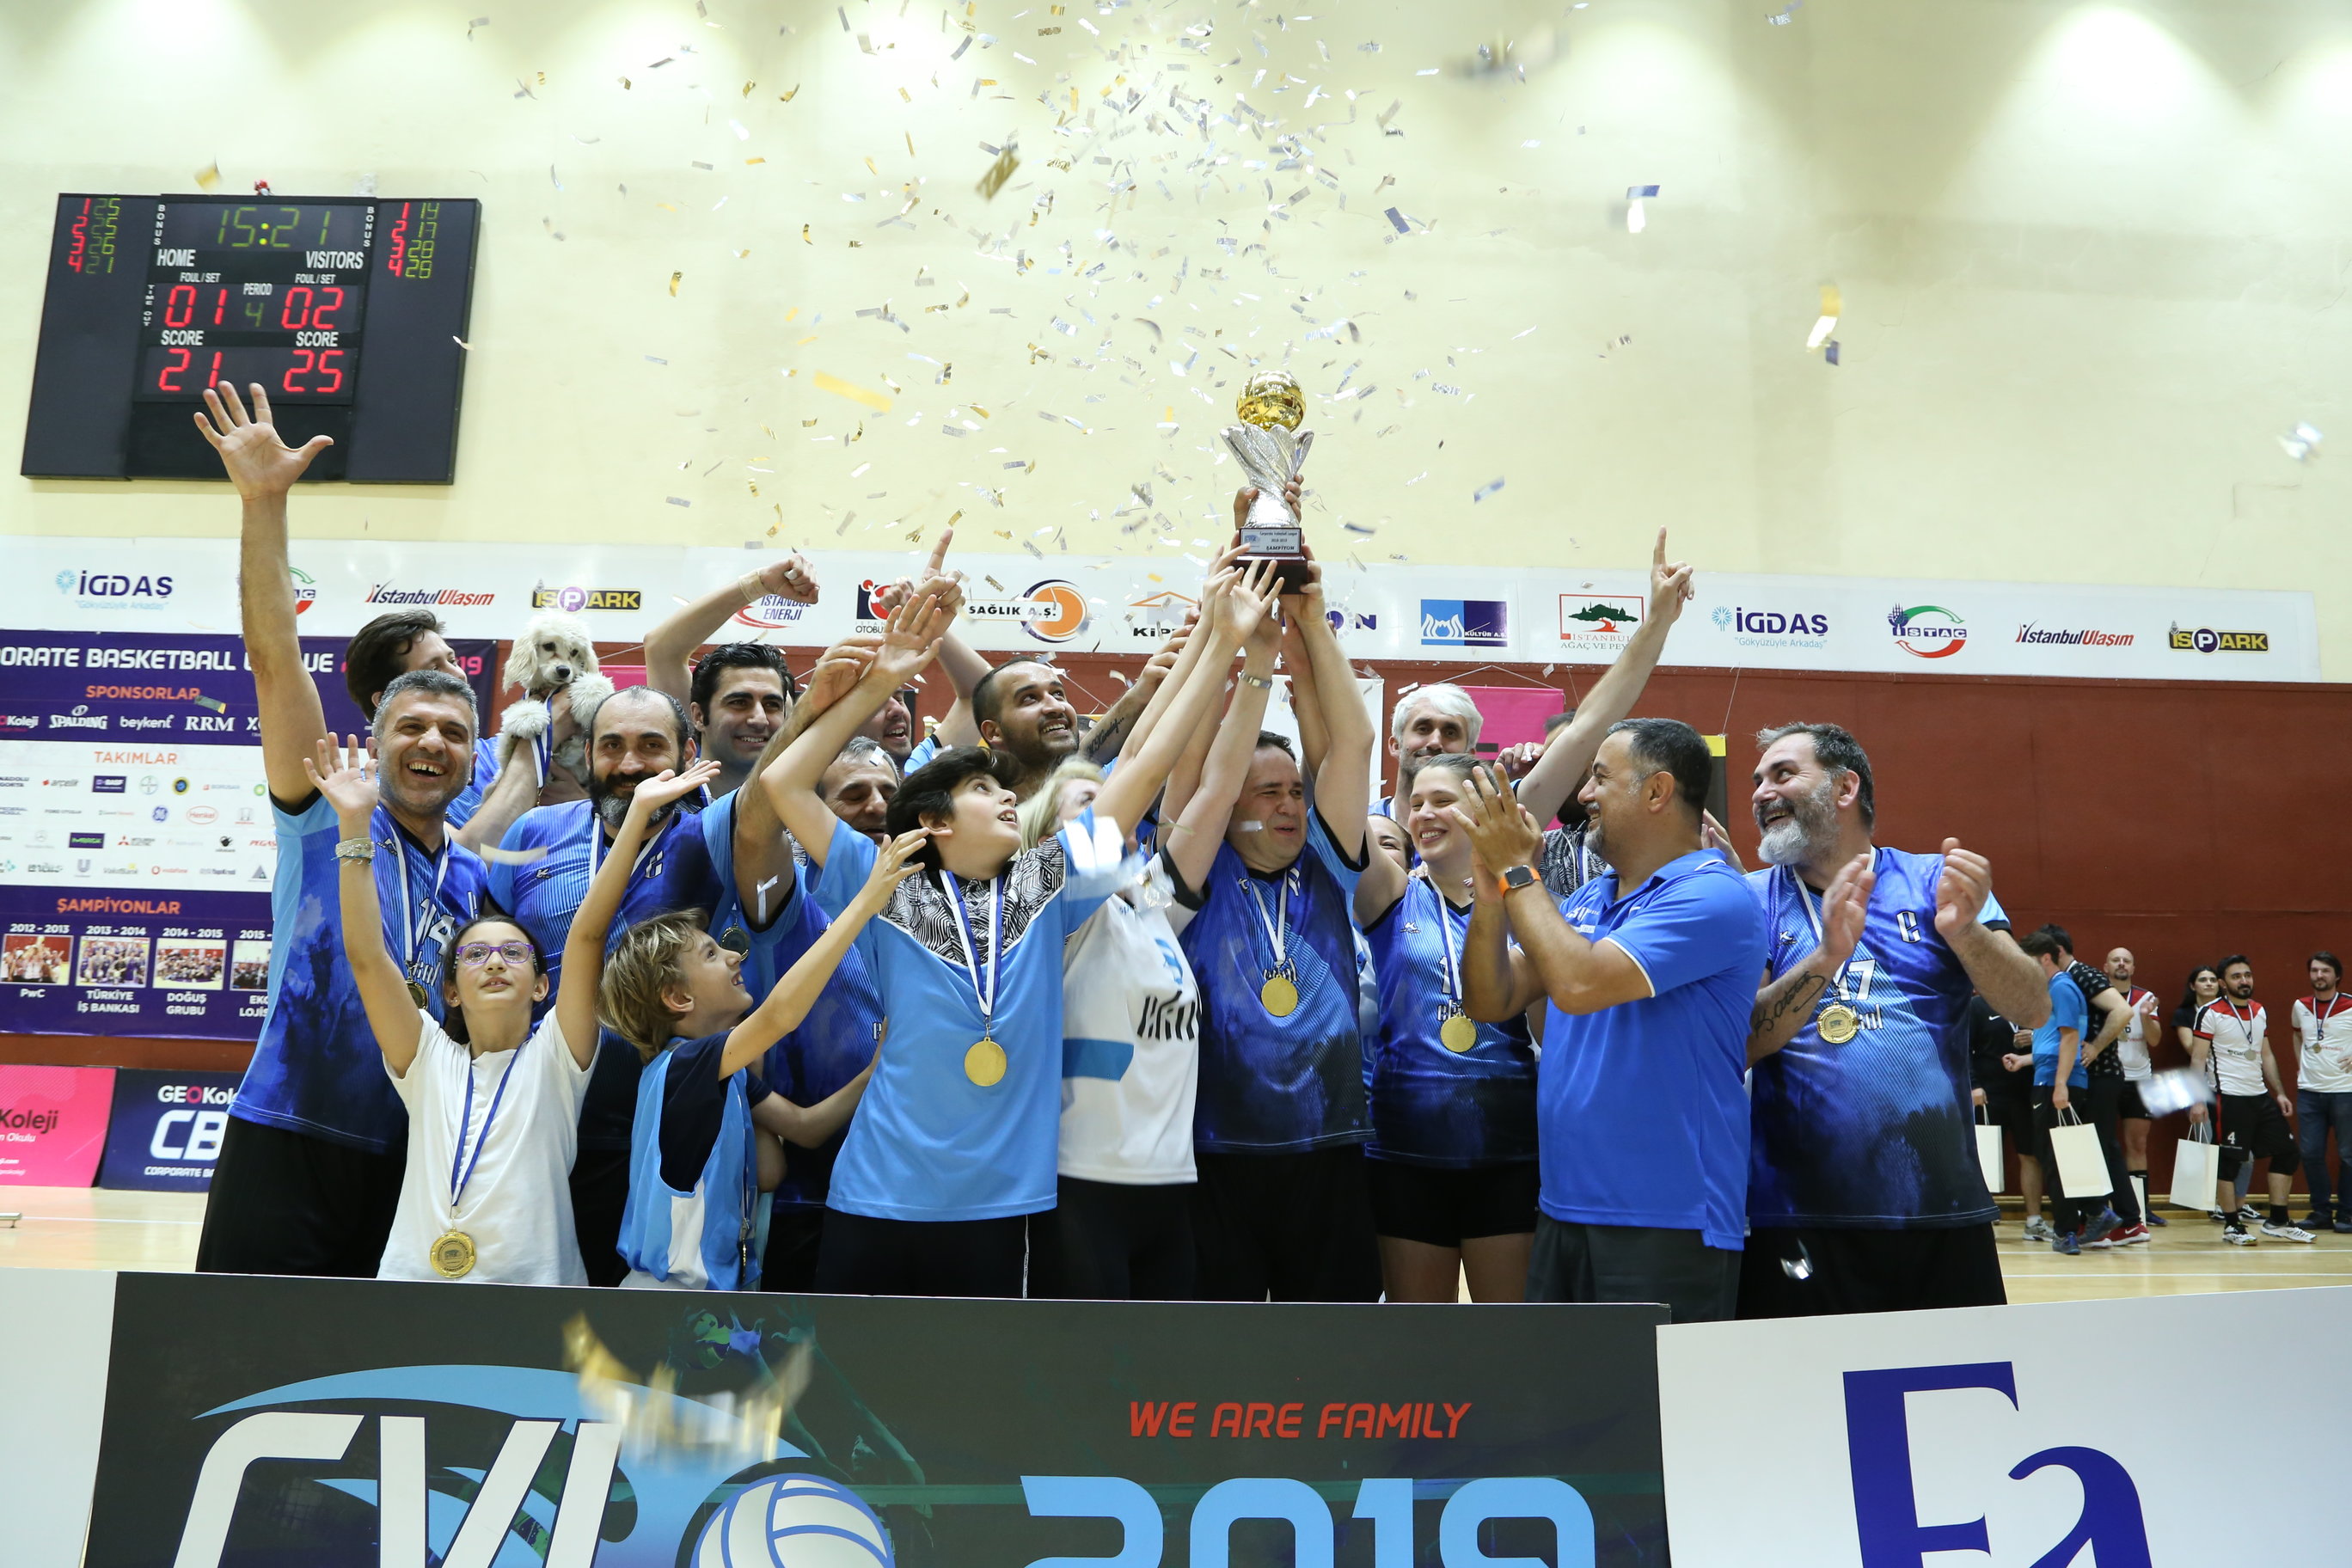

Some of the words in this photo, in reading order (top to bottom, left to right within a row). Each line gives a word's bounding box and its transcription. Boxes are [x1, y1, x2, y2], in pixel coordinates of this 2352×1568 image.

[217, 206, 331, 248] 15:21
[156, 248, 196, 267] HOME
[305, 250, 364, 269] VISITORS
[242, 282, 273, 296] PERIOD
[280, 286, 345, 330] 02
[160, 329, 205, 346] SCORE
[295, 331, 340, 347] SCORE
[158, 348, 223, 392] 21
[282, 349, 344, 393] 25
[969, 603, 1020, 616] SAĞLIK
[1561, 641, 1591, 651] AĞAÇ
[86, 648, 236, 671] BASKETBALL
[85, 686, 200, 701] SPONSORLAR
[49, 715, 108, 731] SPALDING
[119, 715, 175, 730] beykent
[185, 716, 234, 731] RRM
[94, 751, 178, 764] TAKIMLAR
[57, 897, 181, 915] ŞAMPİYONLAR
[10, 923, 35, 933] 2012
[45, 924, 70, 934] 2013
[87, 926, 112, 935] 2013
[120, 926, 146, 935] 2014
[162, 928, 188, 937] 2014
[198, 928, 223, 938] 2015
[240, 929, 265, 940] 2015
[20, 989, 46, 998] PwC
[87, 989, 134, 1001] TÜRKİYE
[167, 990, 207, 1003] DOĞUŞ
[91, 1003, 140, 1014] BANKASI
[167, 1005, 205, 1016] GRUBU
[239, 1006, 267, 1018] LOJİS
[150, 1109, 230, 1161] CB
[2227, 1131, 2236, 1145] 4
[1130, 1401, 1197, 1438] WE
[1210, 1402, 1305, 1438] ARE
[1316, 1402, 1473, 1438] FAMILY
